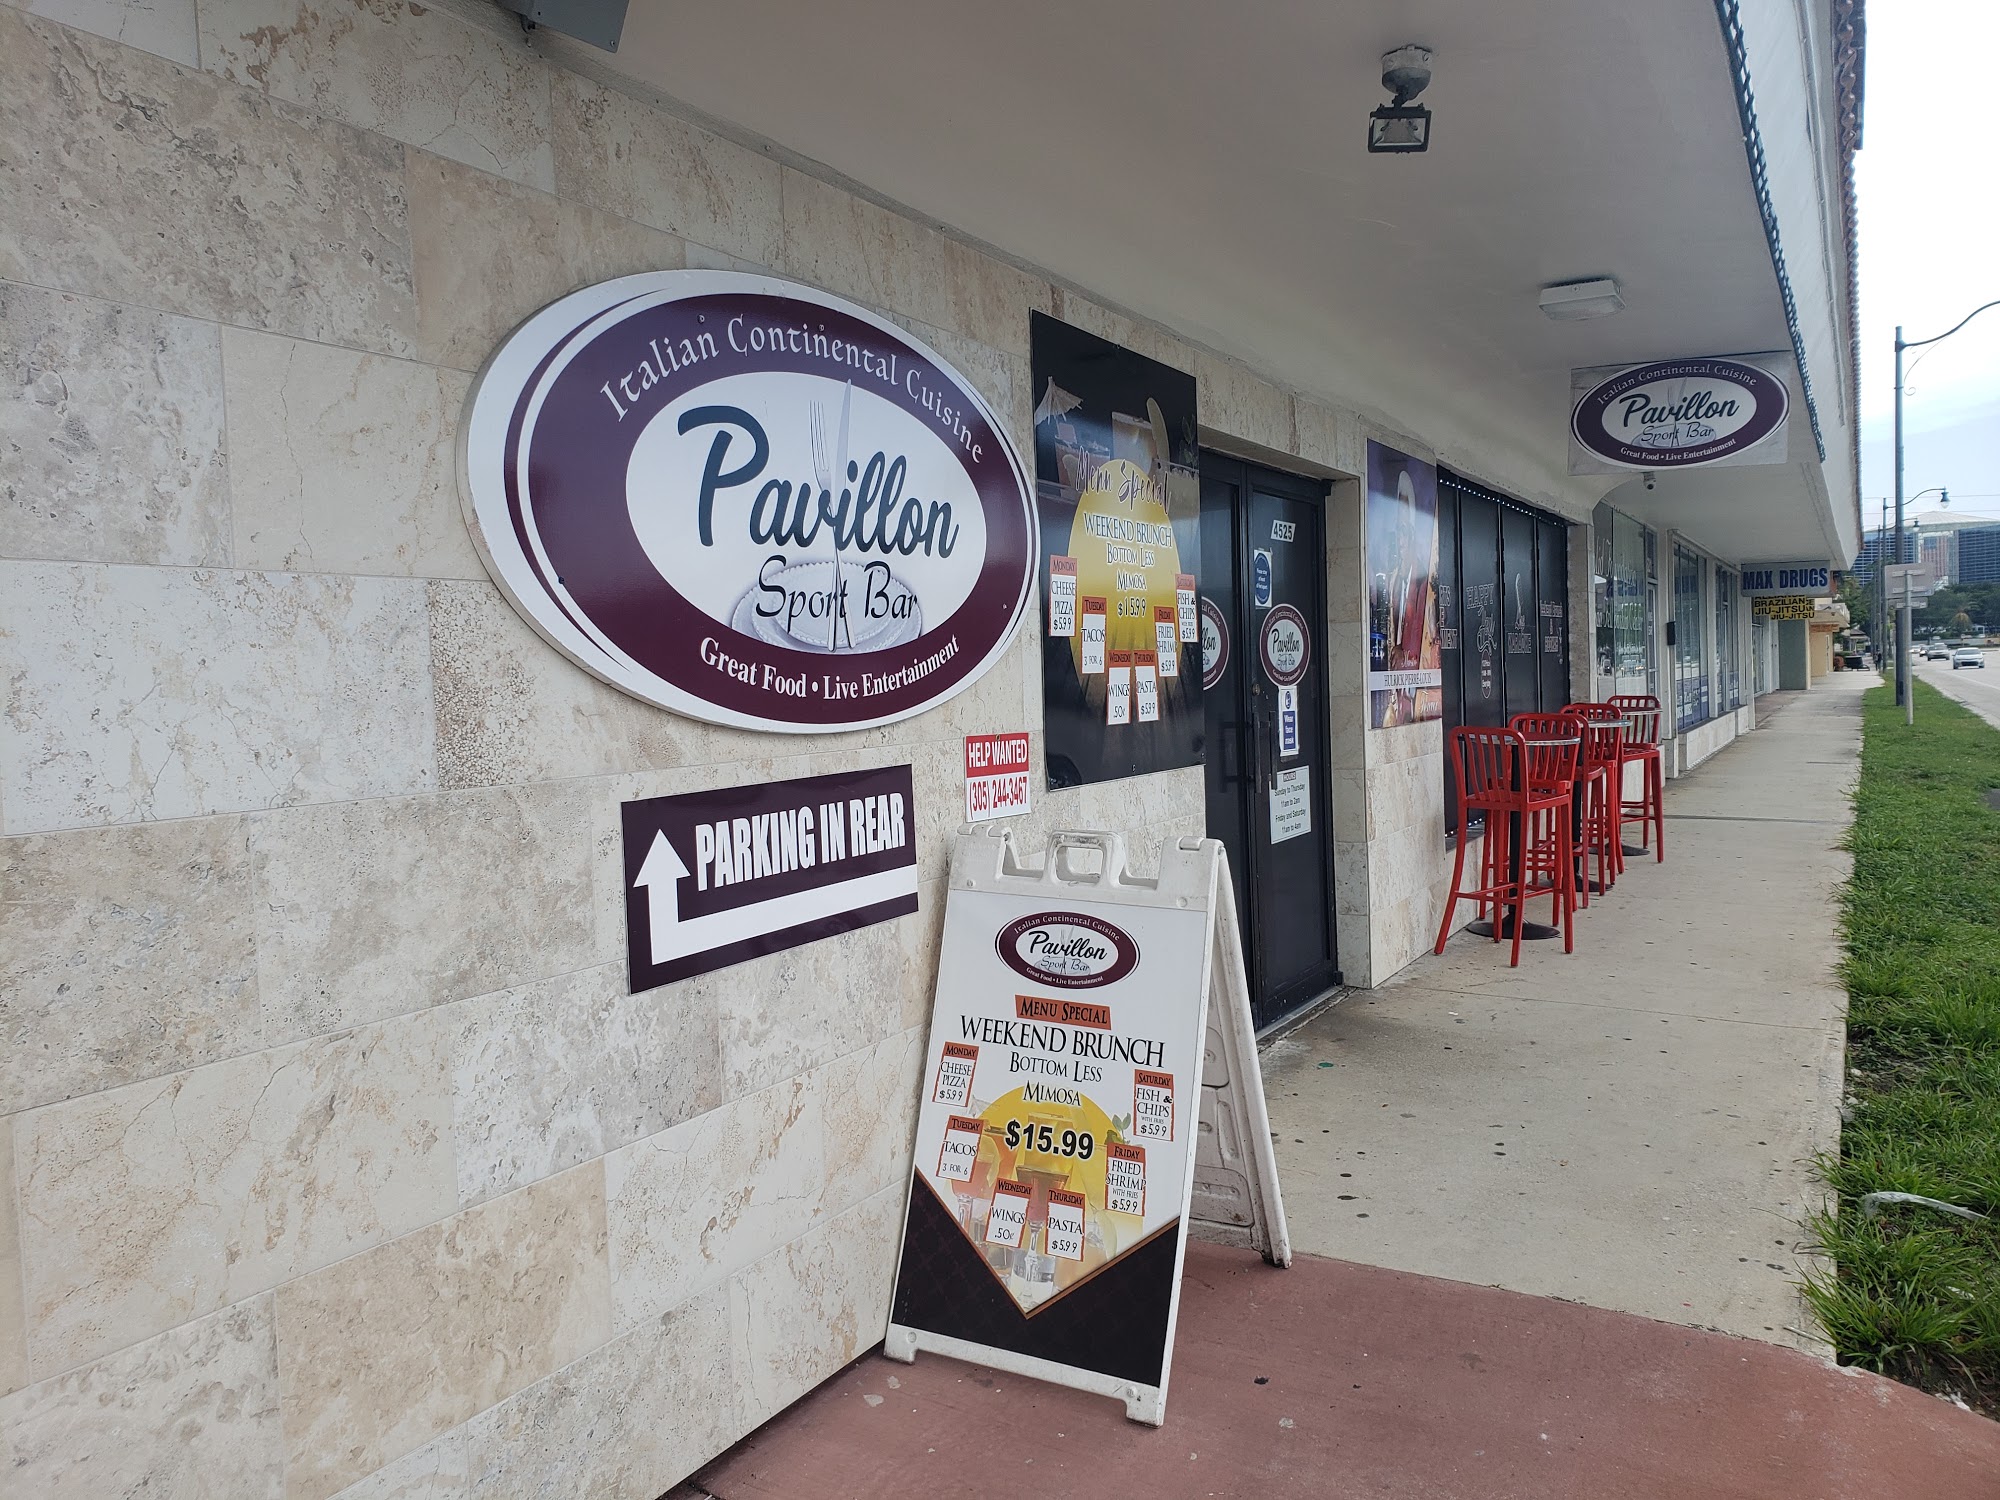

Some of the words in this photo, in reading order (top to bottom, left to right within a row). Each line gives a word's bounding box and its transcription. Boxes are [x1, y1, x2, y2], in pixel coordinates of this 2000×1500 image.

[600, 331, 720, 422] Italian
[728, 313, 899, 384] Continental
[905, 368, 985, 465] Cuisine
[1597, 377, 1635, 405] Italian
[1638, 364, 1711, 382] Continental
[1714, 365, 1757, 386] Cuisine
[1619, 390, 1740, 428] Pavillon
[1641, 423, 1680, 445] Sport
[1686, 421, 1714, 439] Bar
[1620, 446, 1641, 459] Great
[1641, 451, 1660, 461] Food
[1666, 452, 1682, 461] Live
[1683, 438, 1737, 460] Entertainment
[677, 404, 960, 560] Pavillon
[1083, 512, 1135, 542] WEEKEND
[1136, 521, 1173, 549] BRUNCH
[1273, 522, 1293, 541] 4525
[1106, 542, 1139, 565] BOTTOM
[1116, 569, 1147, 592] MIMOSA
[1742, 570, 1774, 590] MAX
[1779, 567, 1828, 589] DRUGS
[754, 554, 849, 634] Sport
[863, 560, 919, 621] Bar
[1051, 580, 1076, 596] CHEESE
[1466, 583, 1494, 609] HAPPY
[1177, 592, 1190, 606] FISH
[1191, 597, 1196, 606] &
[1754, 597, 1805, 608] BRAZILIAN
[1054, 600, 1074, 616] PIZZA
[1178, 606, 1196, 620] CHIPS
[1755, 605, 1805, 616] JIU-JITSU
[1771, 611, 1815, 621] JIU-JITSU
[1082, 627, 1106, 643] TACOS
[1158, 626, 1174, 639] FRIED
[1271, 628, 1300, 654] Pavillon
[699, 635, 759, 687] Great
[762, 664, 808, 699] Food
[823, 672, 859, 700] Live
[861, 634, 960, 697] Entertainment
[1108, 683, 1130, 698] WINGS
[1136, 680, 1157, 694] PASTA
[1284, 714, 1294, 723] Wear
[1285, 725, 1293, 734] face
[967, 739, 991, 769] HELP
[991, 737, 1028, 767] WANTED
[968, 779, 991, 821] (305)
[992, 775, 1028, 810] 244-3467
[695, 805, 815, 892] PARKING
[819, 800, 847, 865] IN
[849, 792, 906, 858] REAR
[1013, 918, 1041, 935] Italian
[1042, 915, 1091, 927] Continental
[1092, 920, 1120, 941] Cuisine
[1028, 930, 1108, 961] Pavillon
[1040, 955, 1068, 971] Sport
[1071, 958, 1090, 972] Bar
[1026, 966, 1040, 979] Great
[1040, 972, 1052, 982] Food
[1056, 977, 1067, 985] Live
[1067, 975, 1104, 985] Entertainment
[1019, 997, 1057, 1017] MENU
[1061, 1002, 1108, 1025] SPECIAL
[960, 1014, 1067, 1053] WEEKEND
[1073, 1030, 1165, 1068] BRUNCH
[945, 1044, 977, 1058] MONDAY
[940, 1060, 972, 1077] CHEESE
[1009, 1051, 1068, 1077] BOTTOM
[1073, 1061, 1103, 1083] LESS
[942, 1074, 967, 1089] PIZZA
[1137, 1072, 1171, 1087] SATURDAY
[939, 1088, 964, 1102] $5.99
[1022, 1080, 1082, 1107] MIMOSA
[1136, 1087, 1161, 1103] FISH
[1162, 1095, 1173, 1104] &
[1136, 1101, 1171, 1118] CHIPS
[951, 1118, 981, 1132] TUESDAY
[1140, 1123, 1167, 1137] $5.99
[1004, 1119, 1094, 1160] $15.99
[942, 1141, 977, 1157] TACOS
[1113, 1145, 1141, 1160] FRIDAY
[942, 1162, 948, 1173] 3
[949, 1163, 961, 1174] FOR
[963, 1165, 968, 1176] 6
[1111, 1160, 1142, 1176] FRIED
[997, 1179, 1033, 1195] WEDNESDAY
[1105, 1172, 1147, 1191] SHRIMP
[1048, 1190, 1084, 1206] THURSDAY
[1111, 1198, 1139, 1213] $5.99
[991, 1206, 1026, 1224] WINGS
[1048, 1217, 1083, 1235] PASTA
[1051, 1239, 1078, 1253] $5.99
